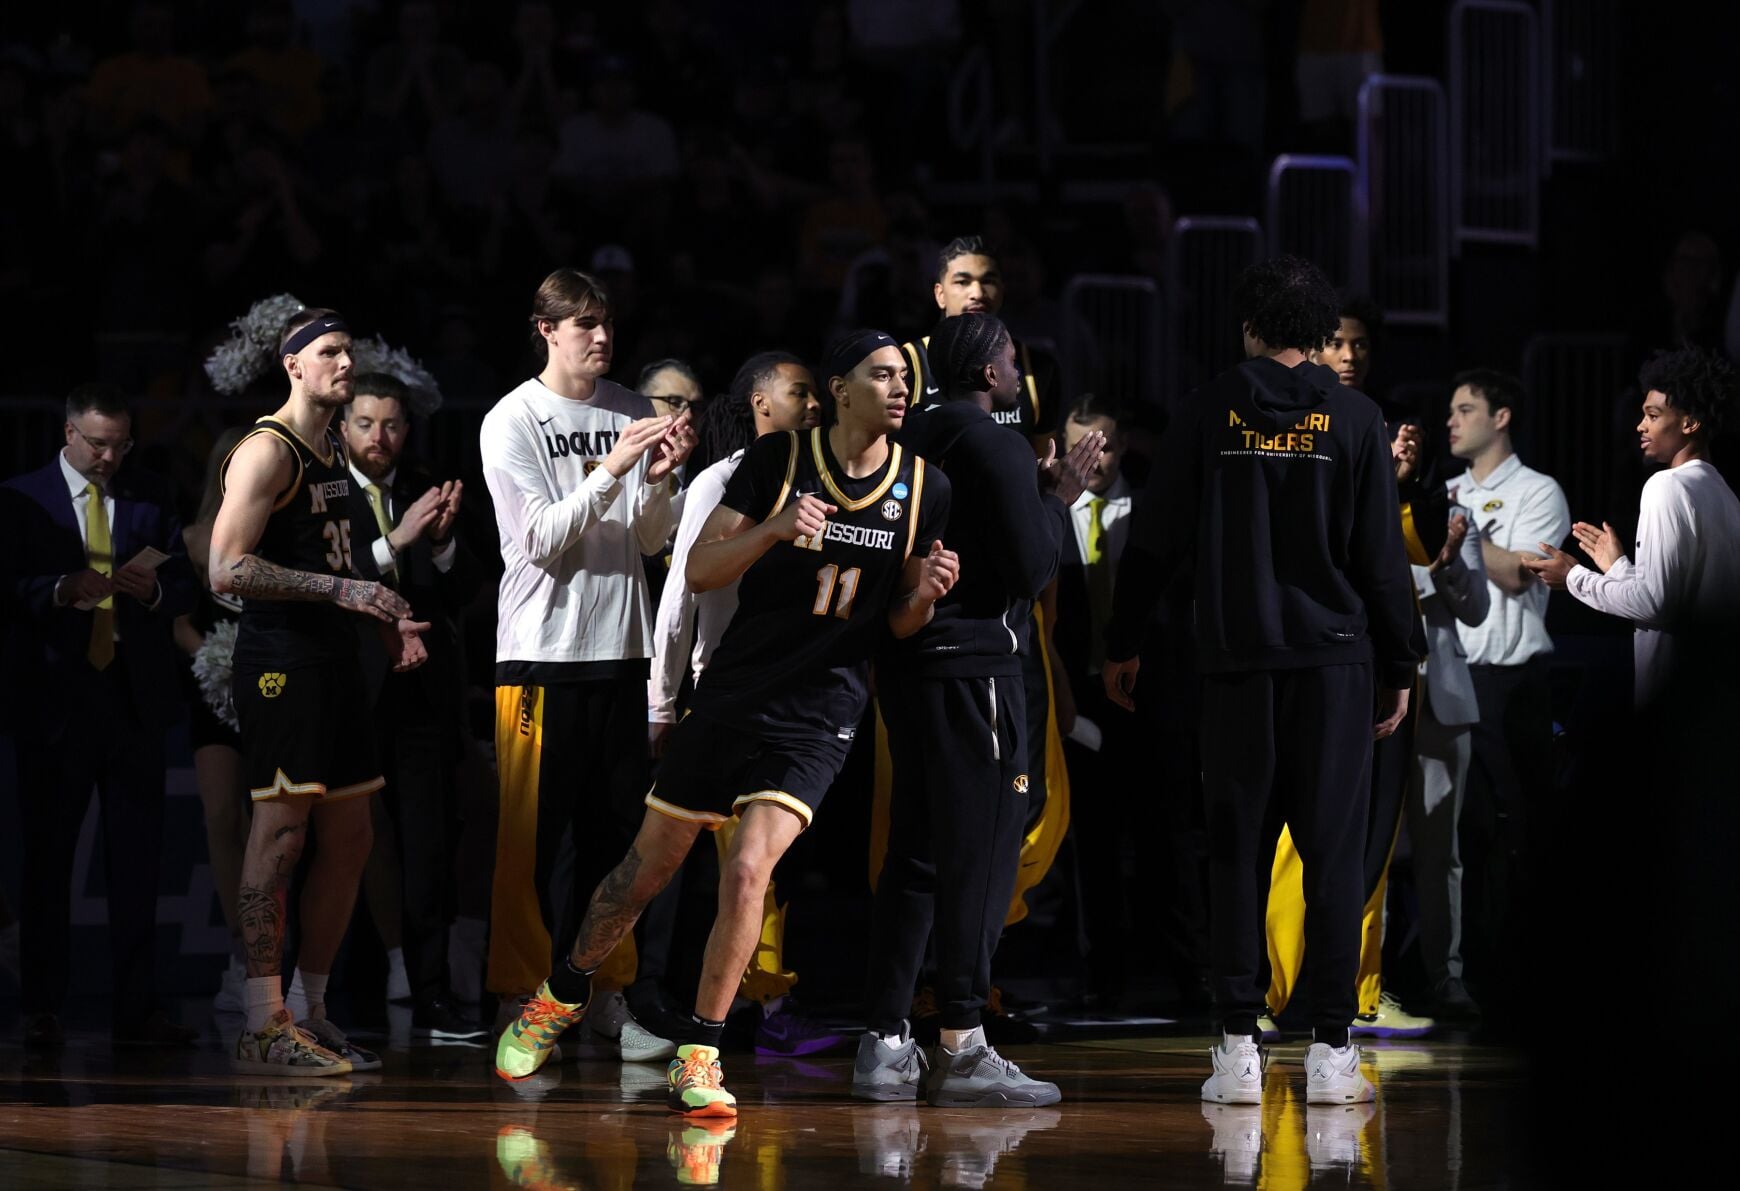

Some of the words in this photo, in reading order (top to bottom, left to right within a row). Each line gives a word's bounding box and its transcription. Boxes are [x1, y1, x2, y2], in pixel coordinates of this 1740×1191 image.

[546, 431, 594, 459] LOCK
[1241, 430, 1314, 452] TIGERS
[883, 501, 901, 519] SEC
[812, 563, 861, 620] 11
